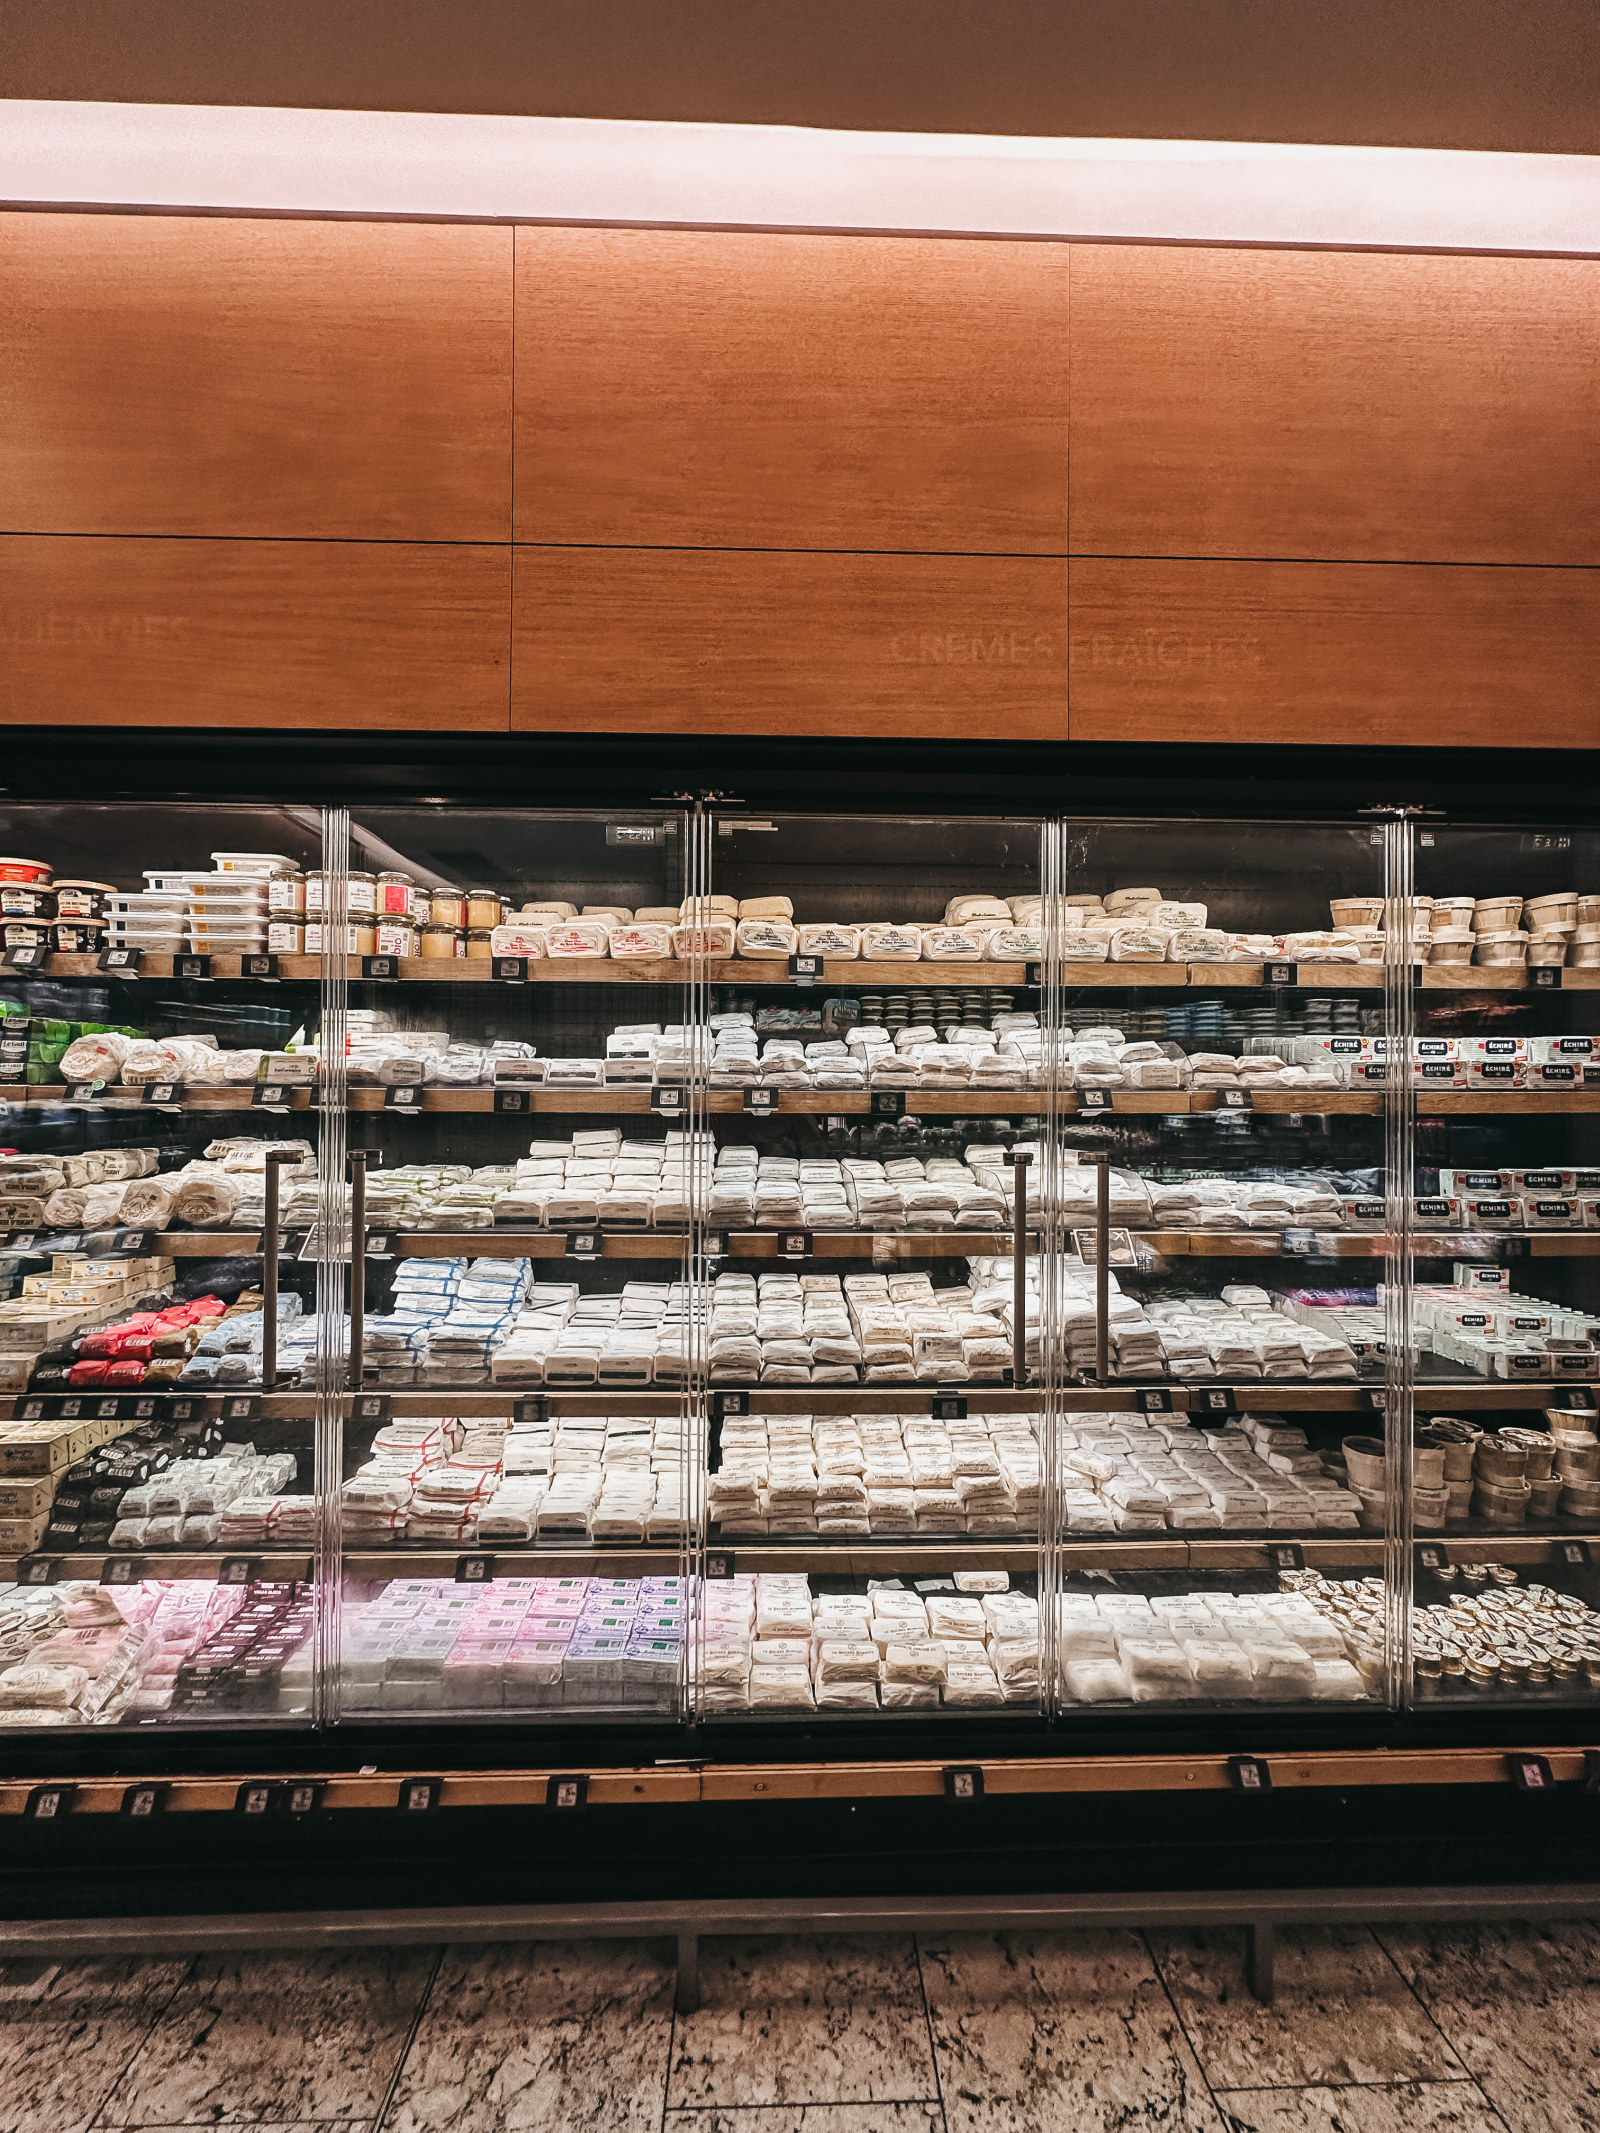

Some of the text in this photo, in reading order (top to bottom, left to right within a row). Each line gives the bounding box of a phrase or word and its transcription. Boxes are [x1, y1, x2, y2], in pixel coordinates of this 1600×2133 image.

[1334, 1040, 1358, 1048] ÉCHIRÉ
[1421, 1042, 1445, 1050] ÉCHIRÉ
[1488, 1041, 1513, 1049] ÉCHIRÉ
[1563, 1040, 1589, 1048] ÉCHIRÉ
[1425, 1064, 1451, 1072] ÉCHIRÉ
[1485, 1064, 1511, 1072] ÉCHIRÉ
[1545, 1066, 1571, 1074] ÉCHIRÉ
[1469, 1175, 1498, 1184] ÉCHIRÉ
[1528, 1174, 1558, 1183] ÉCHIRÉ
[1358, 1204, 1384, 1213] ÉCHIRÉ
[1420, 1202, 1446, 1211] ÉCHIRÉ
[1480, 1203, 1507, 1212] ÉCHIRÉ
[1540, 1203, 1566, 1212] ÉCHIRÉ
